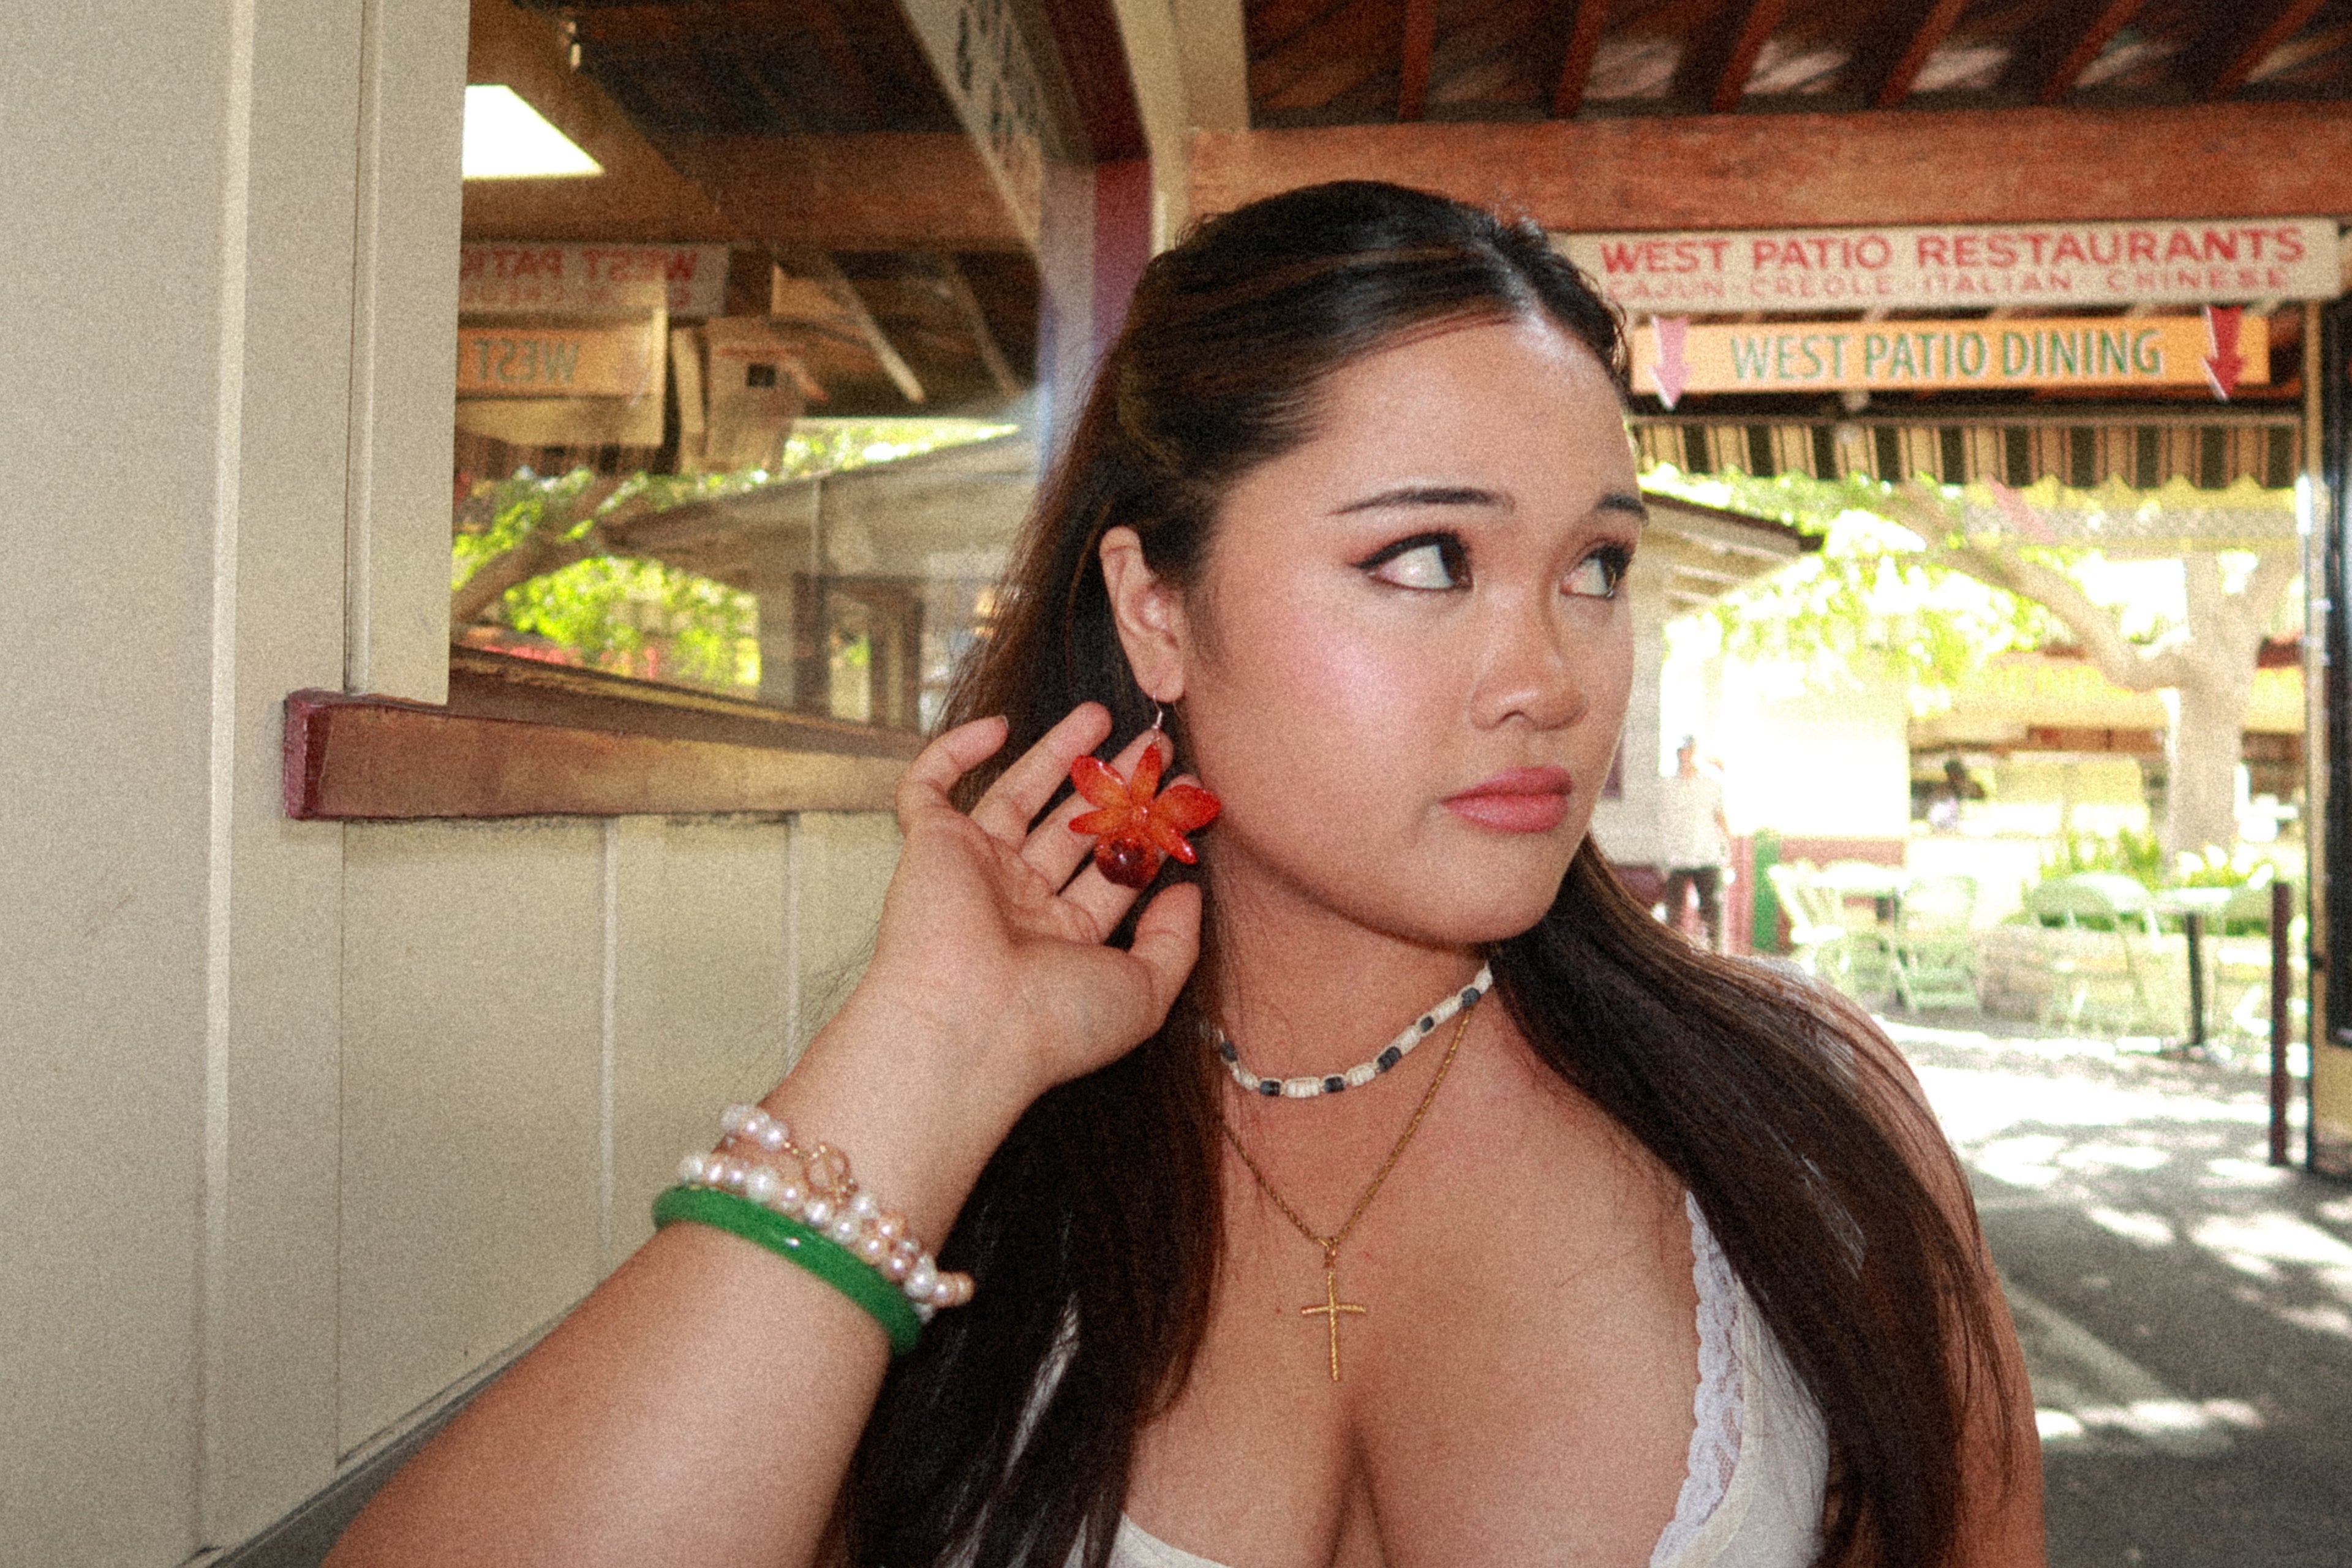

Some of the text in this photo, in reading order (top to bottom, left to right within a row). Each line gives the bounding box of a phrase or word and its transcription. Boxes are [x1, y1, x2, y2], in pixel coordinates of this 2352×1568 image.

[1598, 225, 2305, 274] WEST PATIO RESTAURANTS
[1606, 266, 2289, 299] CAJUN CREOLE ITALIAN CHINESE
[1729, 328, 2167, 381] WEST PATIO DINING
